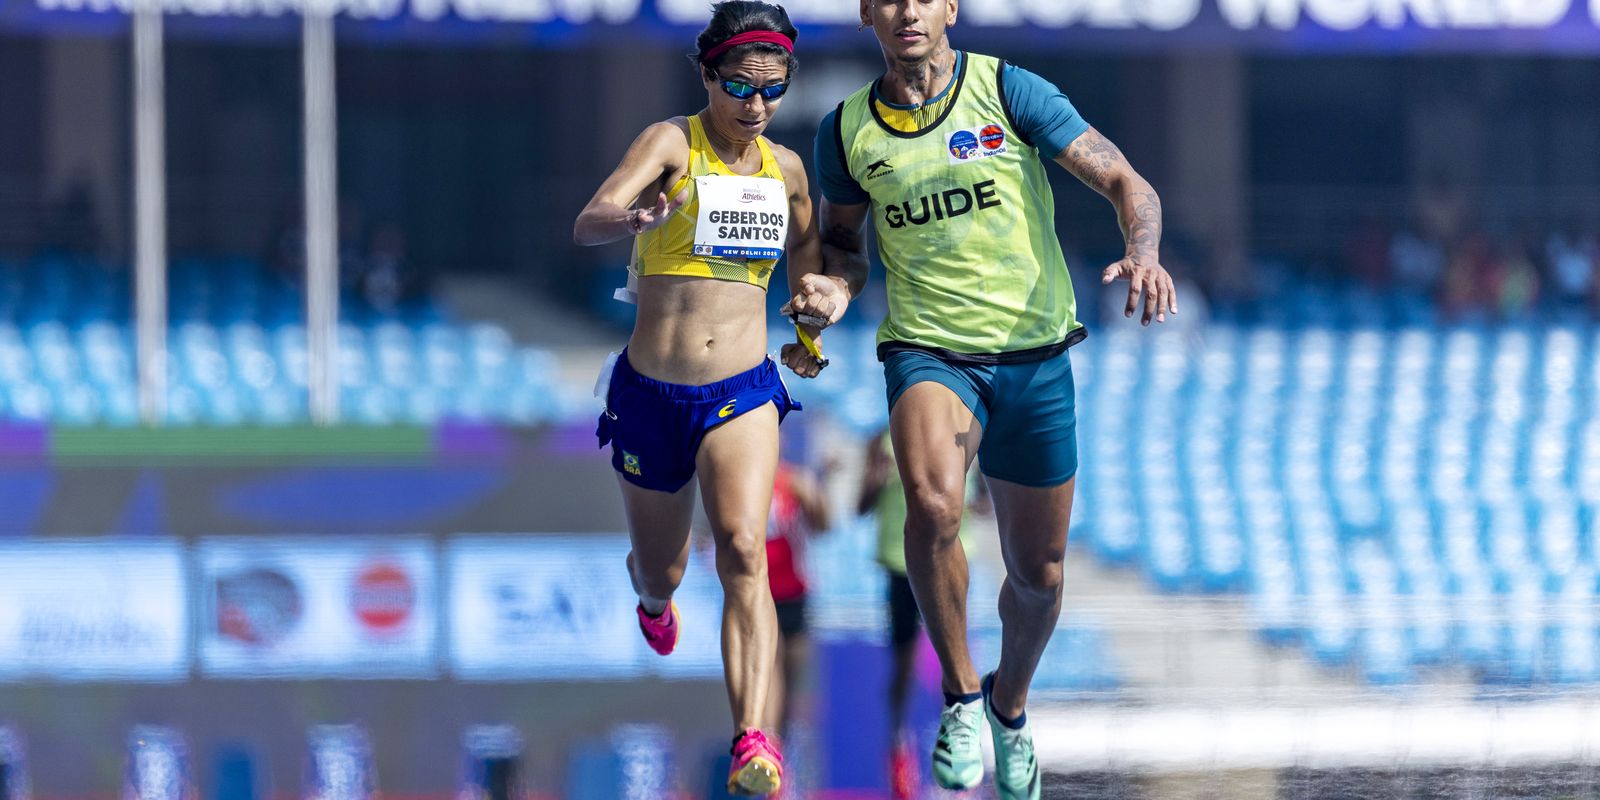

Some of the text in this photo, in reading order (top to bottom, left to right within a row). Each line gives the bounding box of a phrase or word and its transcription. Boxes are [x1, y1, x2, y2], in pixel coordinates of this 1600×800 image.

[741, 193, 766, 201] Athletics
[884, 178, 1002, 228] GUIDE
[709, 210, 784, 227] GEBER DOS
[718, 226, 779, 241] SANTOS
[624, 464, 642, 476] BRA
